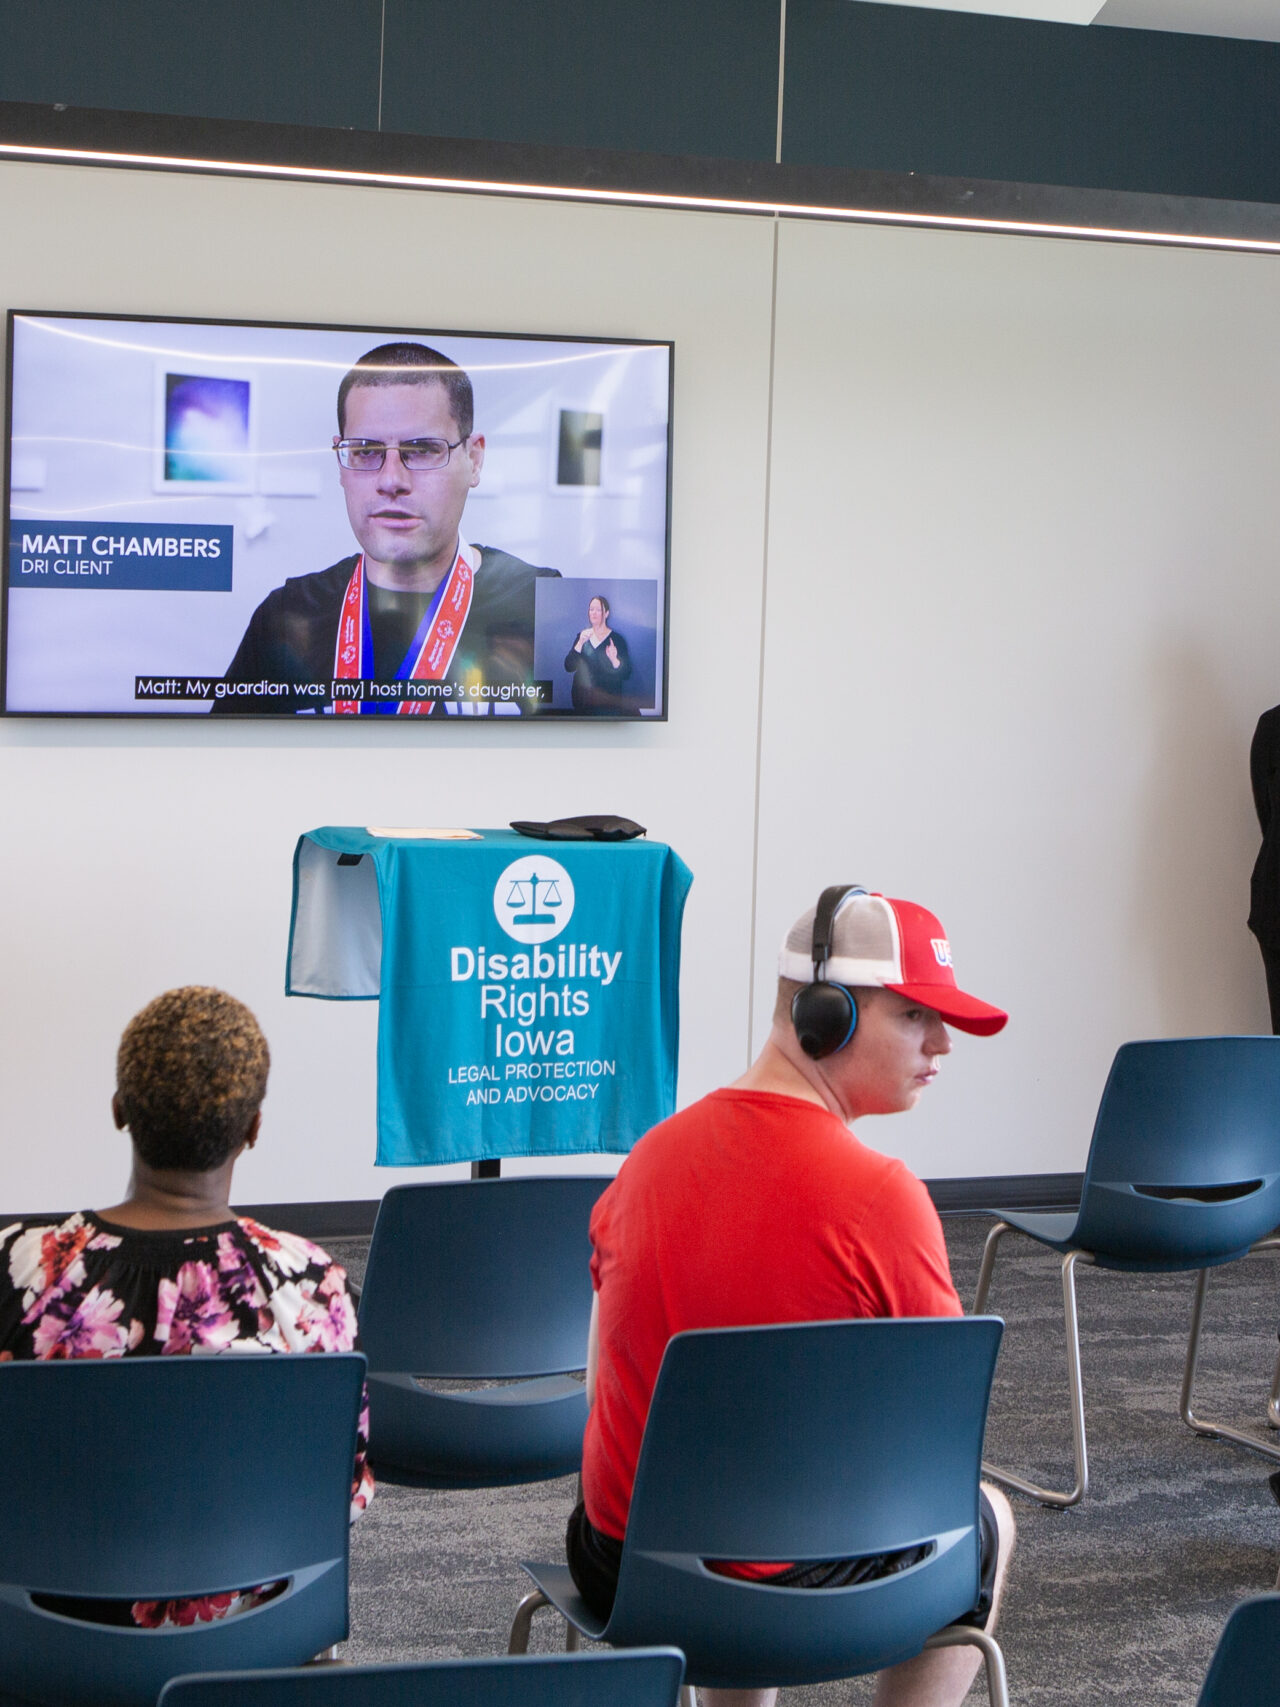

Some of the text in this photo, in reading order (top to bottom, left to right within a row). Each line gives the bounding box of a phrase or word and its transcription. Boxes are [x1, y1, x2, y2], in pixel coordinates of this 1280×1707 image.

[22, 534, 222, 559] MATT CHAMBERS
[21, 559, 114, 576] DRI CLIENT
[137, 679, 545, 700] Matt: My guardian was [my] host home's daughter,
[451, 944, 623, 986] Disability
[481, 983, 590, 1027] Rights
[496, 1023, 575, 1058] Iowa
[448, 1060, 616, 1084] LEGAL PROTECTION
[466, 1083, 600, 1106] AND ADVOCACY
